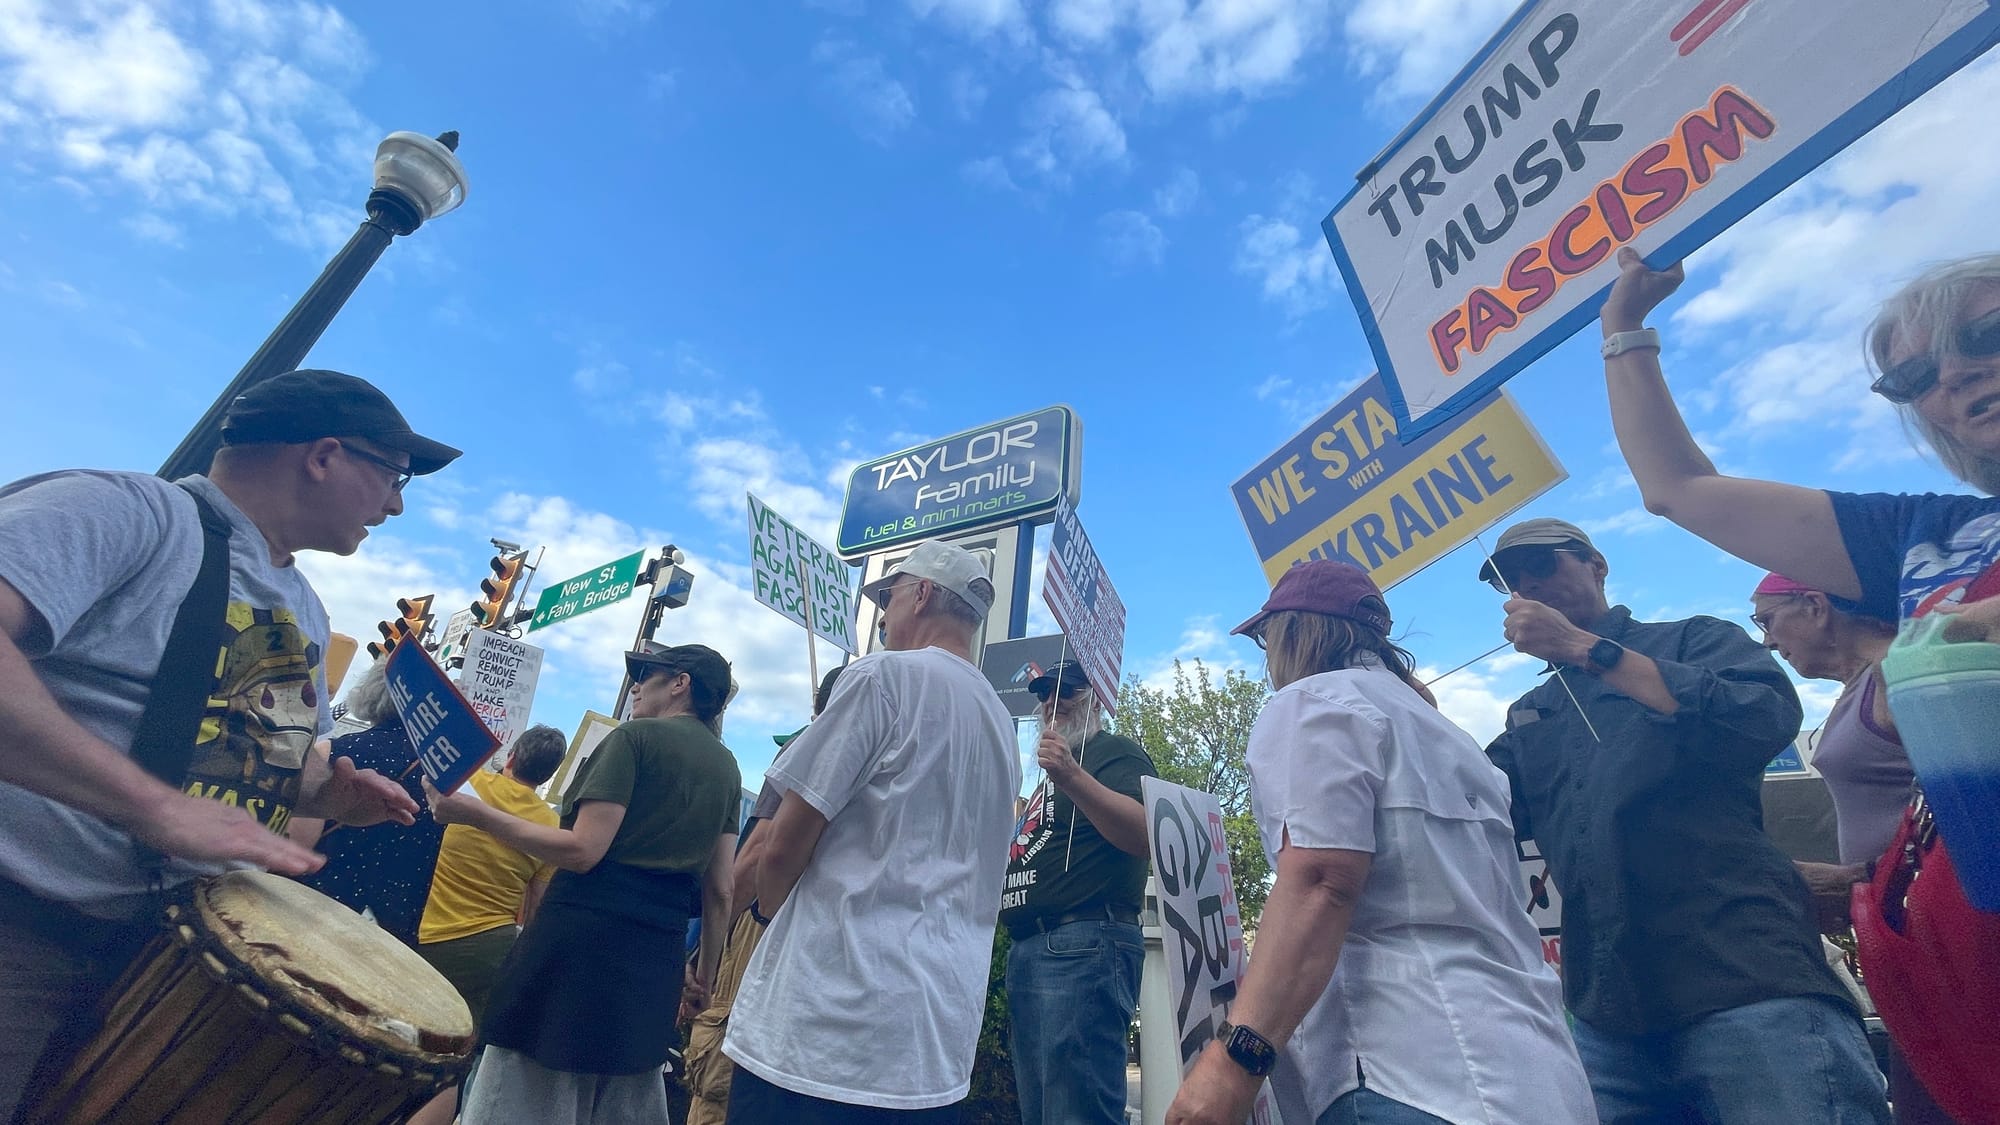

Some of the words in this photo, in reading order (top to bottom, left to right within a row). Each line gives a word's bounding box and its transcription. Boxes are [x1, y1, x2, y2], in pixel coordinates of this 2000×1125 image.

[1368, 12, 1579, 237] TRUMP
[1424, 88, 1624, 289] MUSK
[1429, 86, 1777, 374] FASCISM
[871, 420, 1039, 491] TAYLOR
[1348, 458, 1384, 490] WITH
[1248, 454, 1317, 525] WE
[1291, 433, 1514, 574] KRAINE
[864, 520, 898, 540] fuel
[902, 516, 917, 531] &
[921, 504, 960, 526] mini
[964, 490, 1026, 516] marts
[748, 495, 849, 588] VETERAN
[1058, 496, 1098, 581] HANDS
[560, 578, 592, 599] New
[598, 565, 617, 584] St
[1063, 540, 1091, 597] OFF!
[547, 599, 578, 621] Fahy
[583, 581, 629, 608] Bridge
[266, 630, 283, 651] 2
[479, 649, 523, 669] CONVICT
[483, 635, 526, 657] IMPEACH
[475, 671, 514, 690] TRUMP
[477, 661, 517, 680] REMOVE
[473, 692, 504, 708] MAKE
[1046, 801, 1055, 823] HOPE
[1021, 829, 1053, 866] DIVERSITY
[1008, 869, 1037, 889] MAKE
[1003, 889, 1028, 910] GREAT
